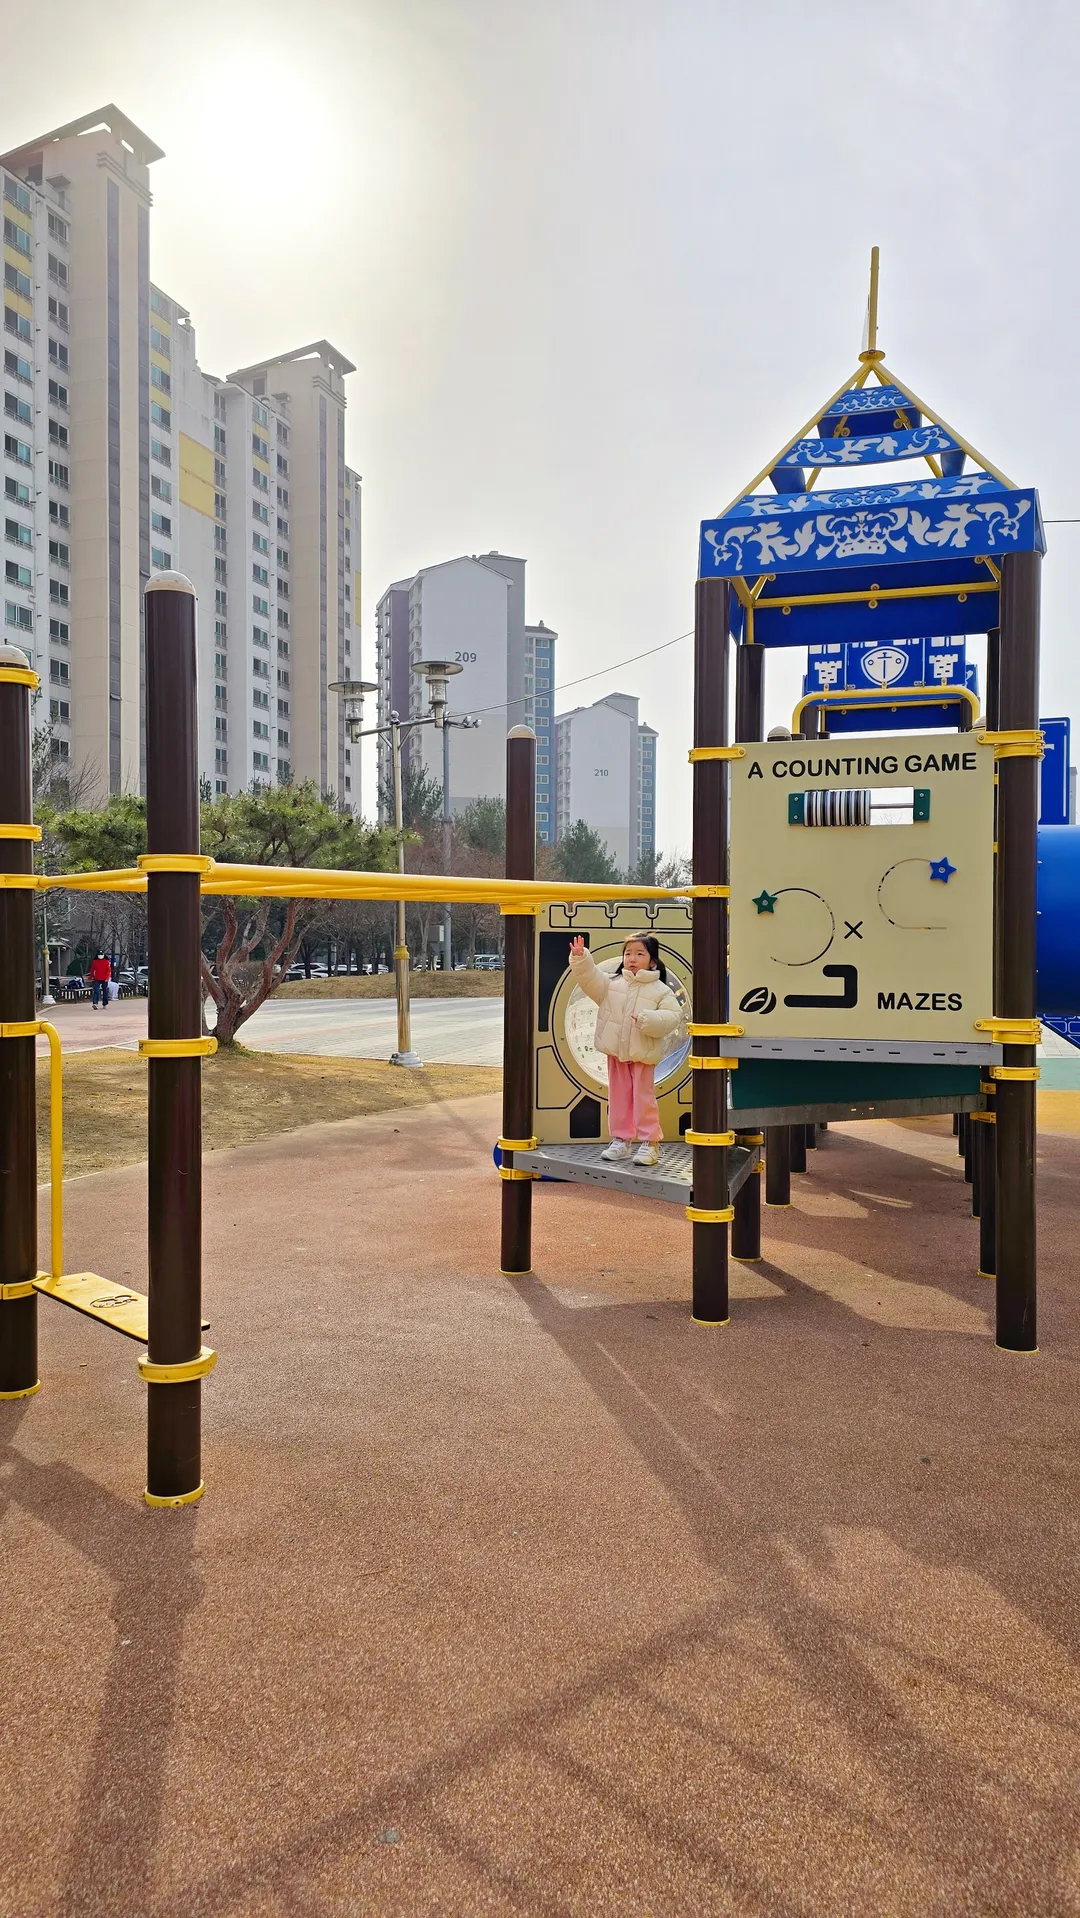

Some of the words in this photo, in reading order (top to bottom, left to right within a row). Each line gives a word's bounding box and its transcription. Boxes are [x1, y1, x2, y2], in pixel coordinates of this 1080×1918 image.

[454, 651, 478, 663] 209
[594, 768, 609, 778] 210
[747, 761, 764, 779] A
[772, 756, 899, 779] COUNTING
[904, 752, 977, 773] GAME
[877, 992, 963, 1011] MAZES
